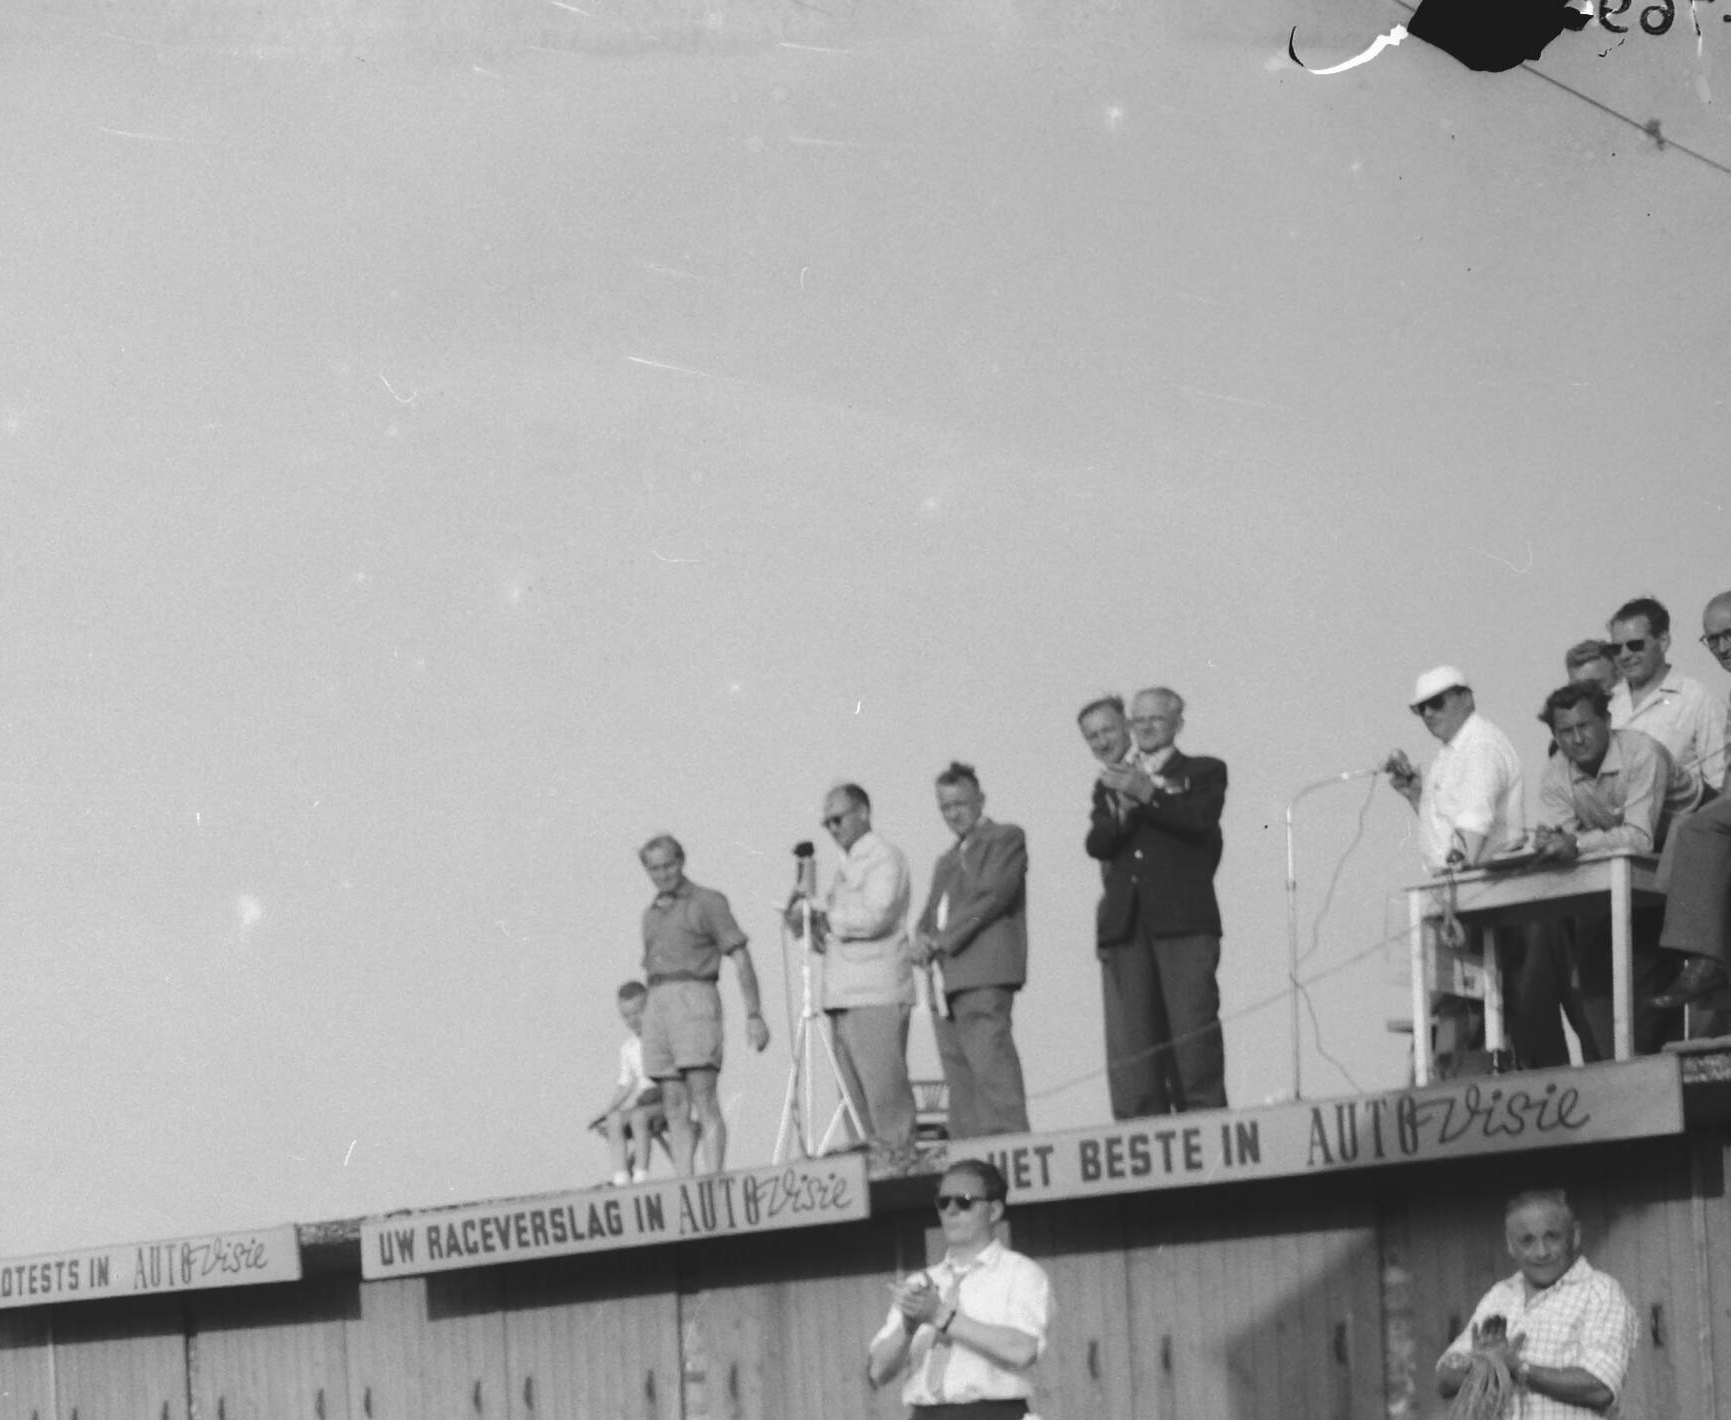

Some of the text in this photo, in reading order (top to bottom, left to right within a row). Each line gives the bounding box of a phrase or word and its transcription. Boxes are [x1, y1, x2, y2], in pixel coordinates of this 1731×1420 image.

[1079, 1130, 1203, 1182] BESTE
[1221, 1122, 1262, 1165] IN
[380, 1231, 416, 1265] UW
[428, 1200, 623, 1261] RACEVERSLAG
[635, 1193, 665, 1232] IN
[89, 1256, 110, 1288] IN
